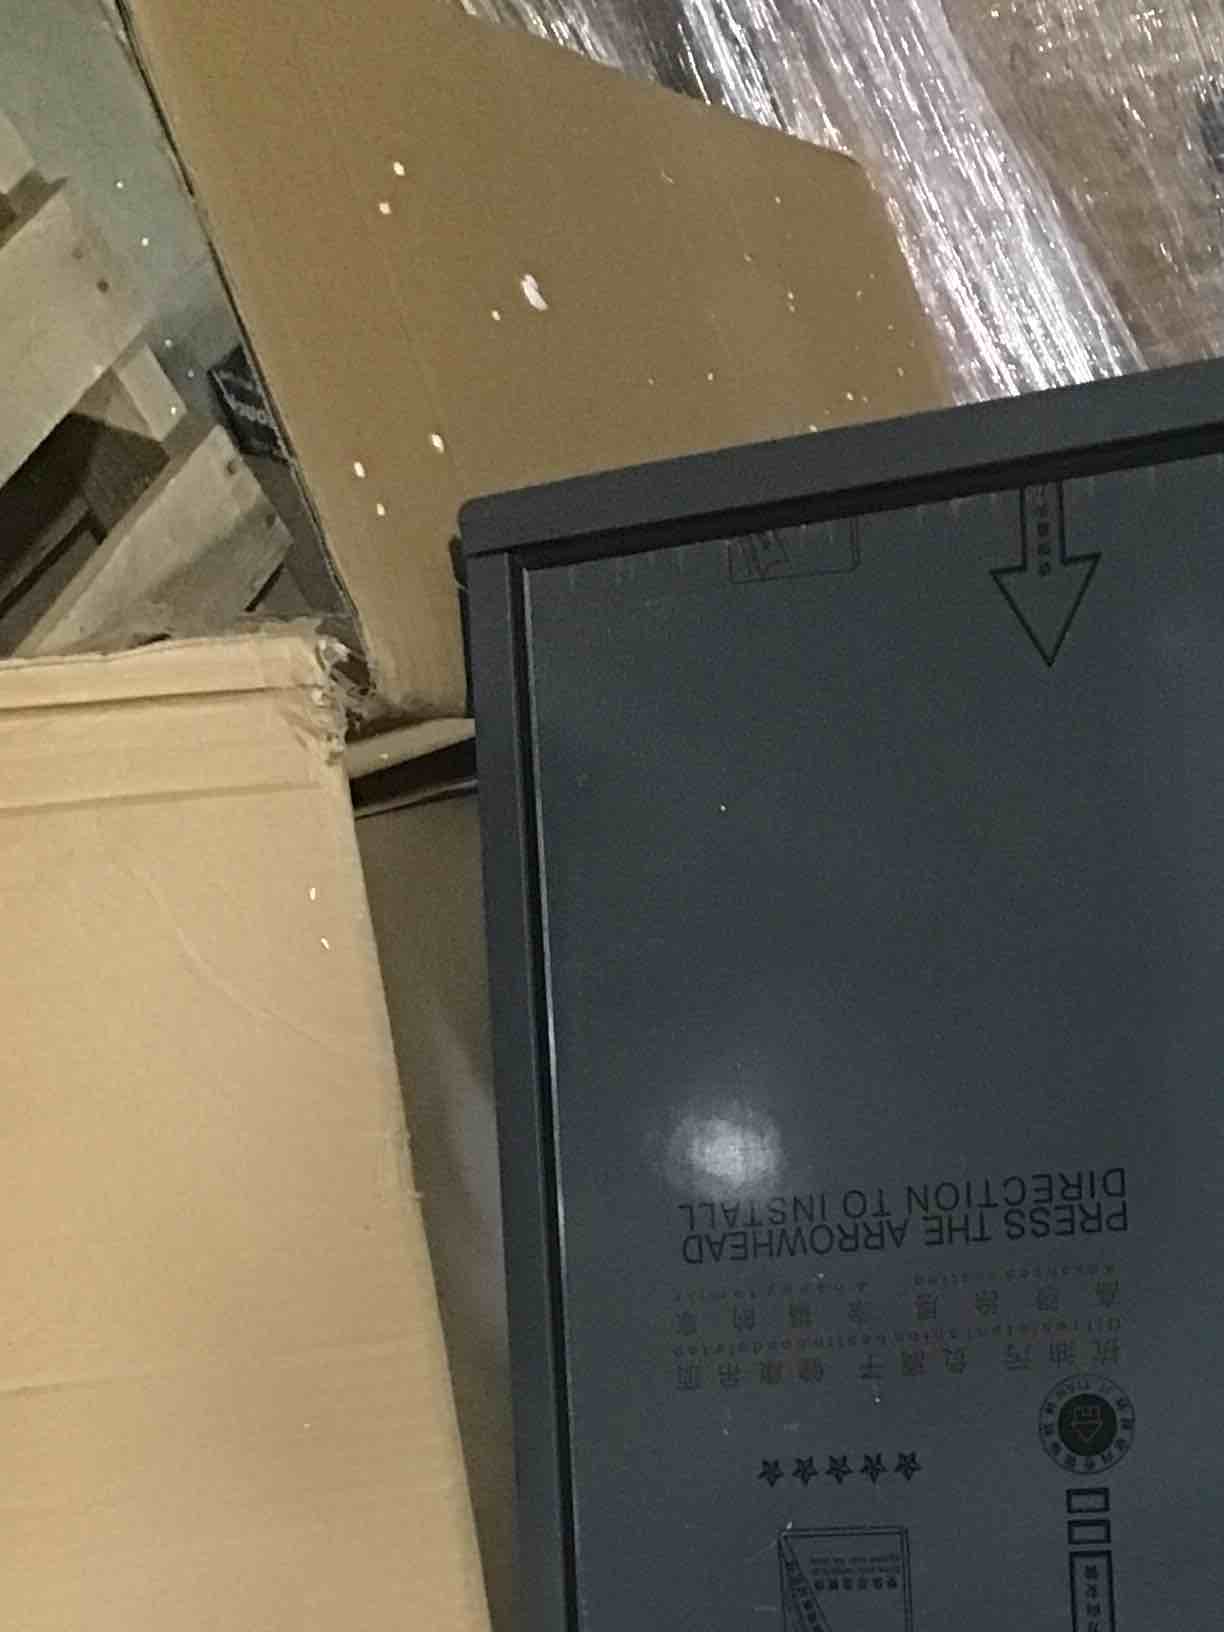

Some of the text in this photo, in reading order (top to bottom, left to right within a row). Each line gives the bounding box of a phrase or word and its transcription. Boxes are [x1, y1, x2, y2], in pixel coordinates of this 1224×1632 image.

[678, 1168, 1126, 1231] DIRECTION TO INSTALL
[682, 1200, 1128, 1265] PRESS THE ARROWHEAD
